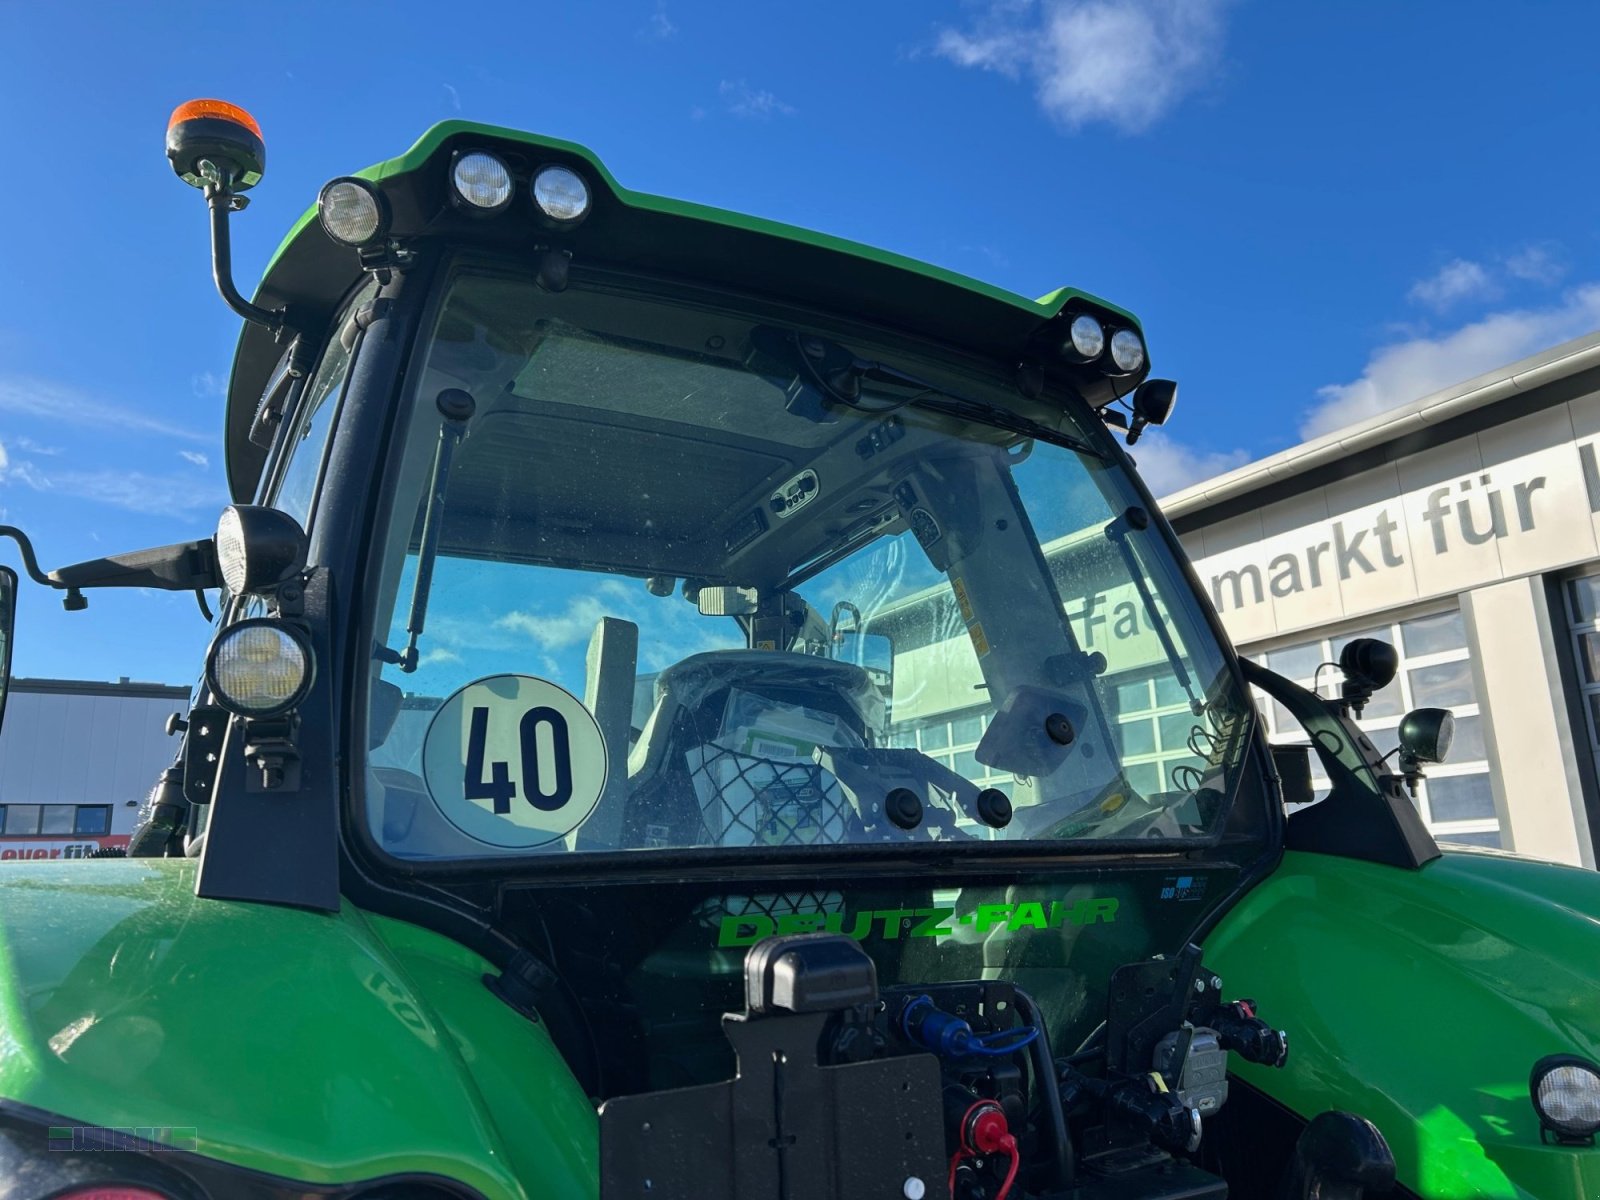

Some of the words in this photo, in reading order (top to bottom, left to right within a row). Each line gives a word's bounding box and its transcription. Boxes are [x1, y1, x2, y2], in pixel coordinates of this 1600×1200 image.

[1423, 473, 1546, 556] für
[464, 706, 573, 814] 40
[1, 848, 61, 860] ever
[64, 844, 92, 860] fit
